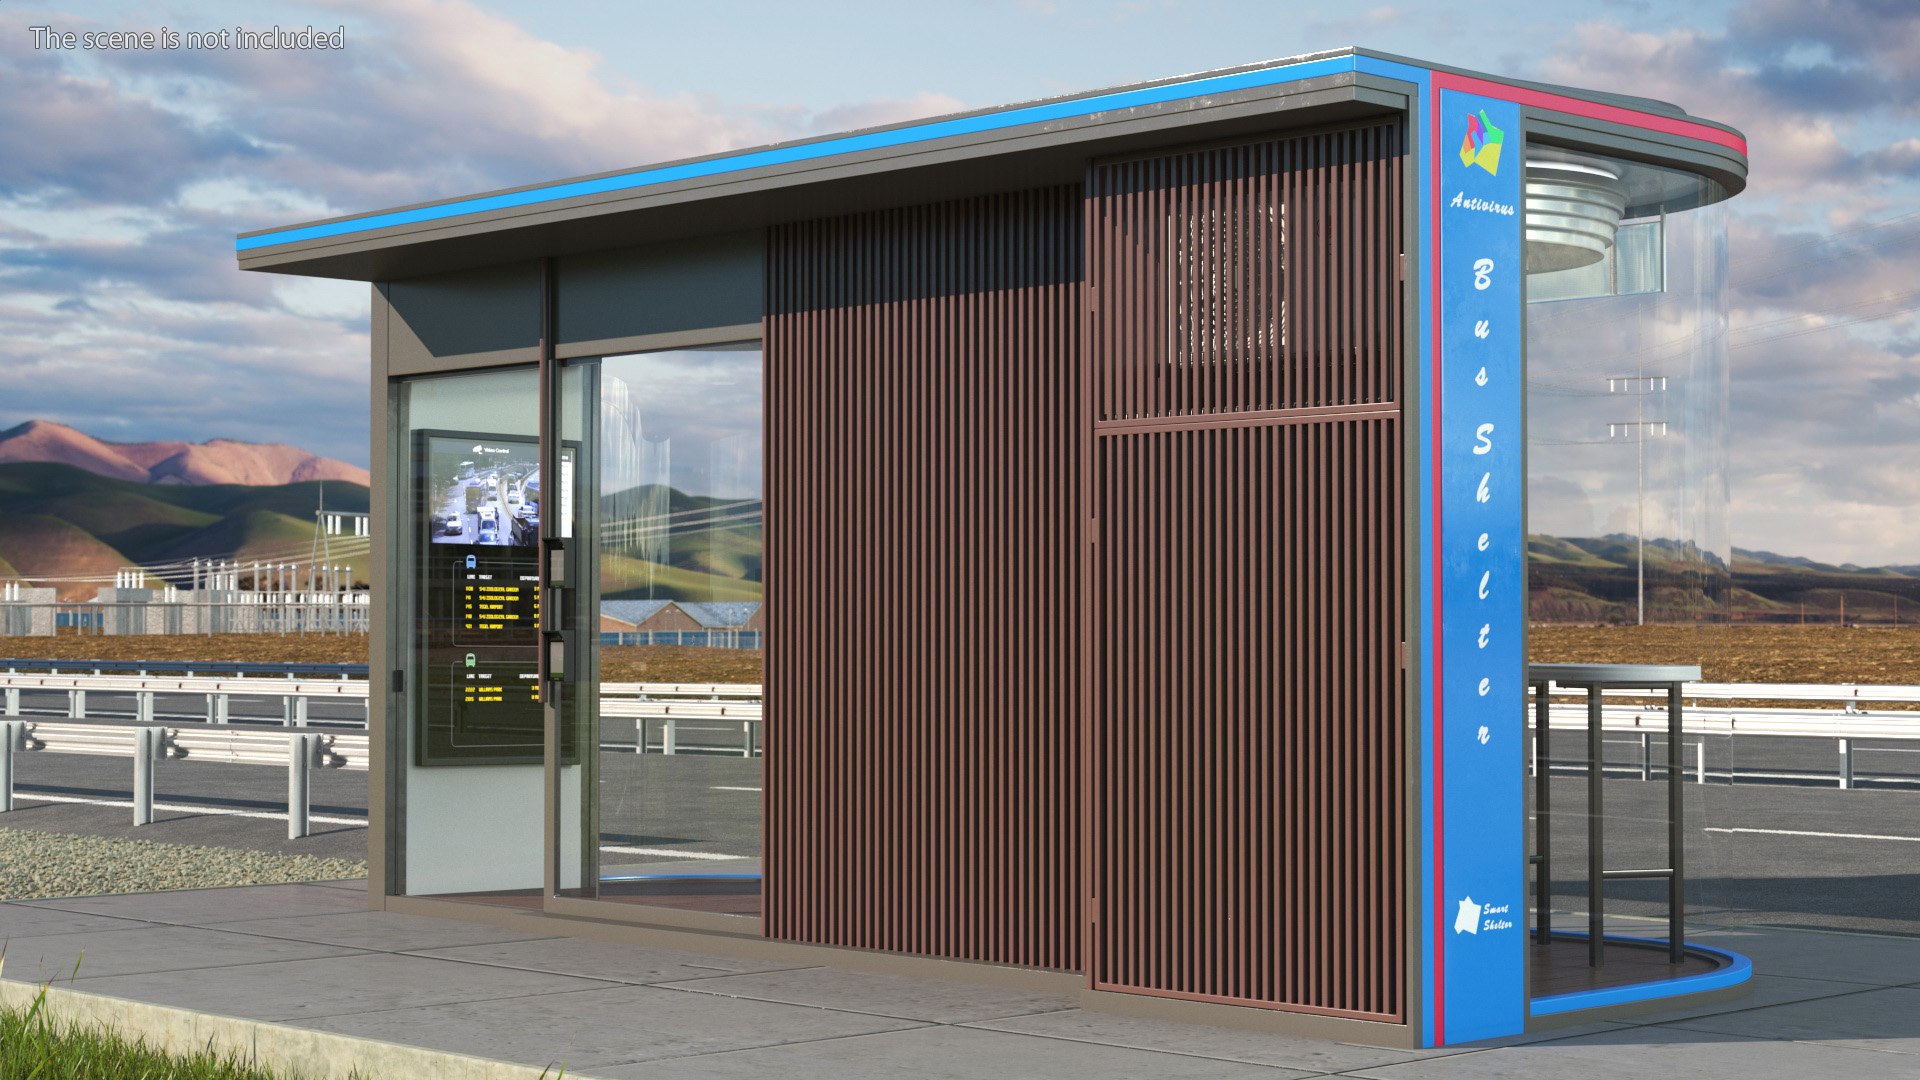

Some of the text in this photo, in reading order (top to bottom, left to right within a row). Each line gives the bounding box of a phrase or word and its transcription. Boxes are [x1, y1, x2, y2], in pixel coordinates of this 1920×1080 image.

[1450, 191, 1514, 216] Antivirus
[1473, 258, 1495, 745] Bus Shelter
[1483, 903, 1509, 915] Smart
[1483, 919, 1513, 931] Shelter
